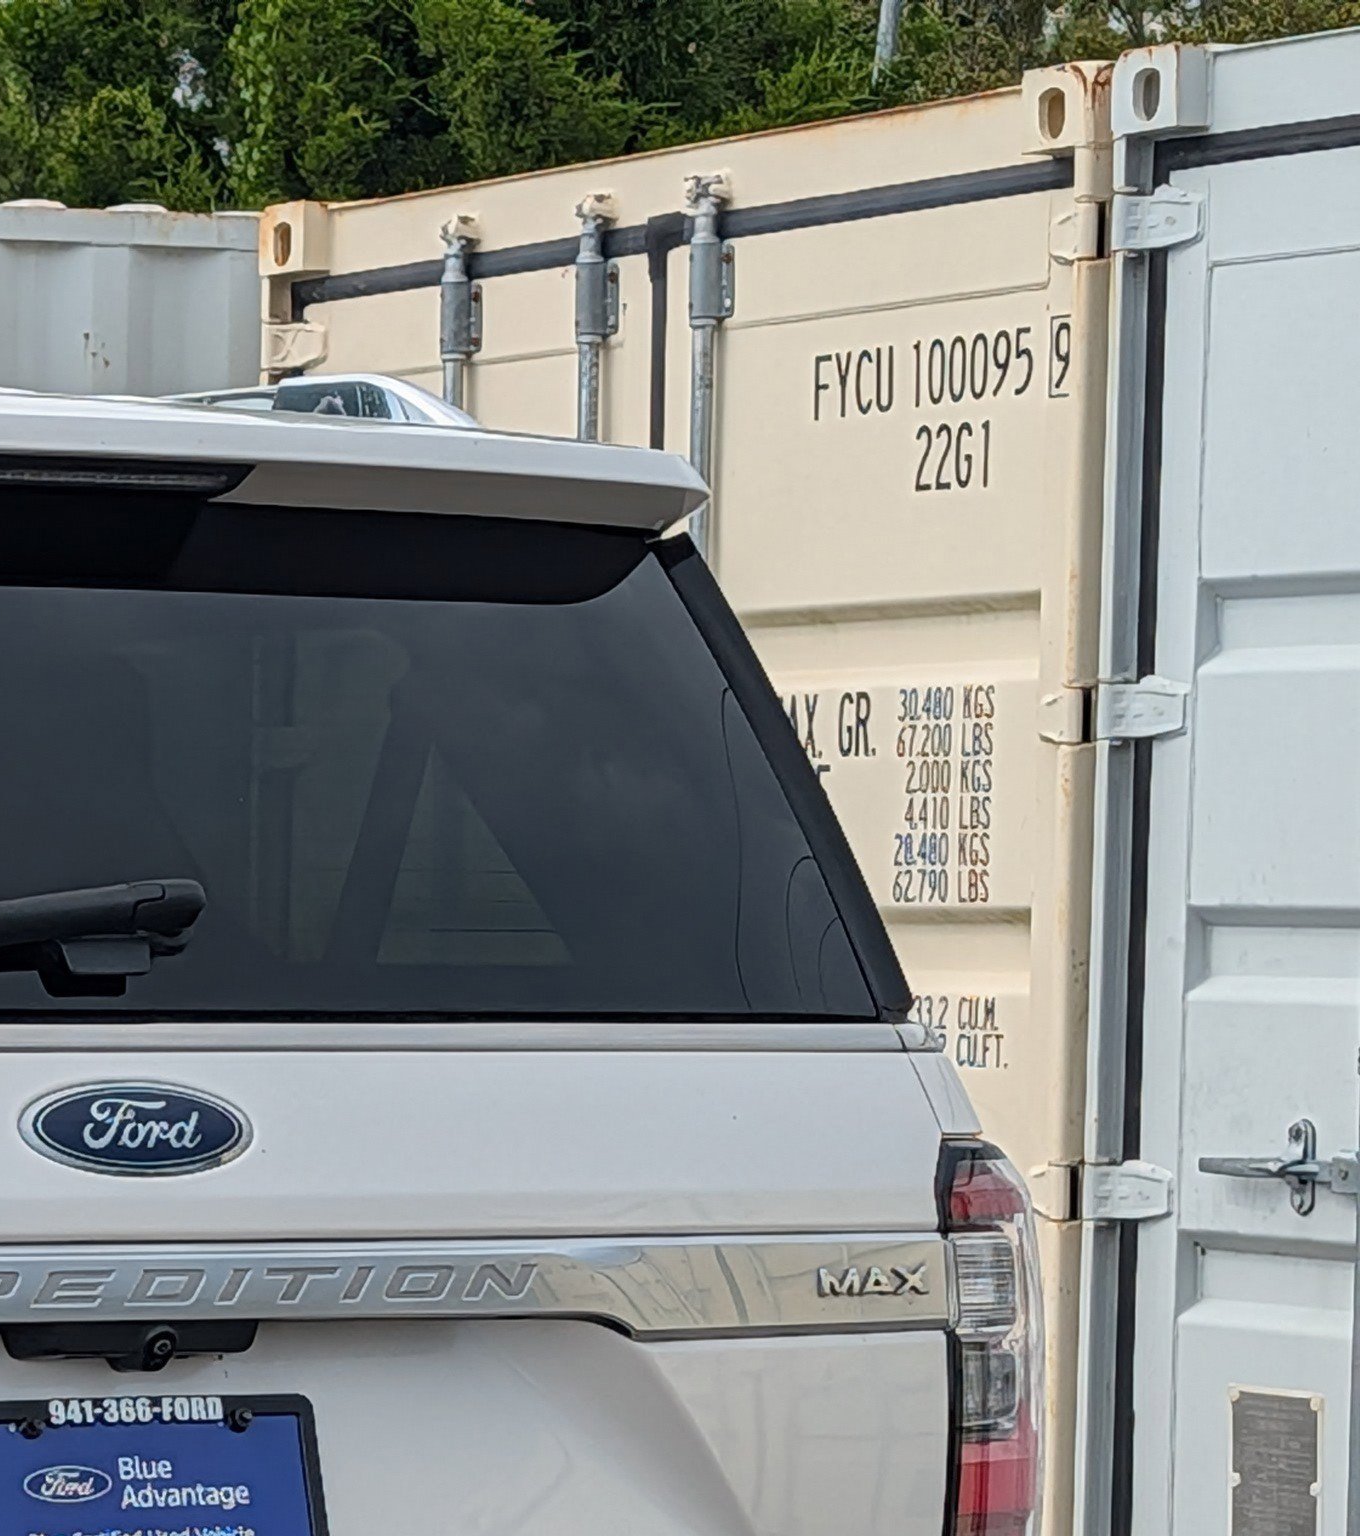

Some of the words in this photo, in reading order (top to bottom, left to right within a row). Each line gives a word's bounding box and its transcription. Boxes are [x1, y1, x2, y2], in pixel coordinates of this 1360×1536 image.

[813, 345, 894, 421] FYCU
[912, 326, 1034, 408] 100095
[1054, 321, 1071, 389] 9
[915, 419, 990, 491] 22G1
[897, 686, 954, 721] 30.480
[962, 684, 995, 719] KGS
[838, 692, 876, 757] GR.
[896, 723, 952, 757] 67.200
[961, 722, 993, 756] LBS
[960, 759, 992, 793] KGS
[904, 796, 949, 830] 4.410
[959, 796, 992, 829] LBS
[958, 832, 990, 866] KGS
[958, 868, 989, 903] LBS
[83, 1098, 202, 1149] Ford
[817, 1260, 929, 1298] MAX
[48, 1397, 224, 1426] 941-366-FORD
[41, 1469, 95, 1496] Ford
[118, 1456, 173, 1481] Blue
[121, 1483, 251, 1510] Advantage
